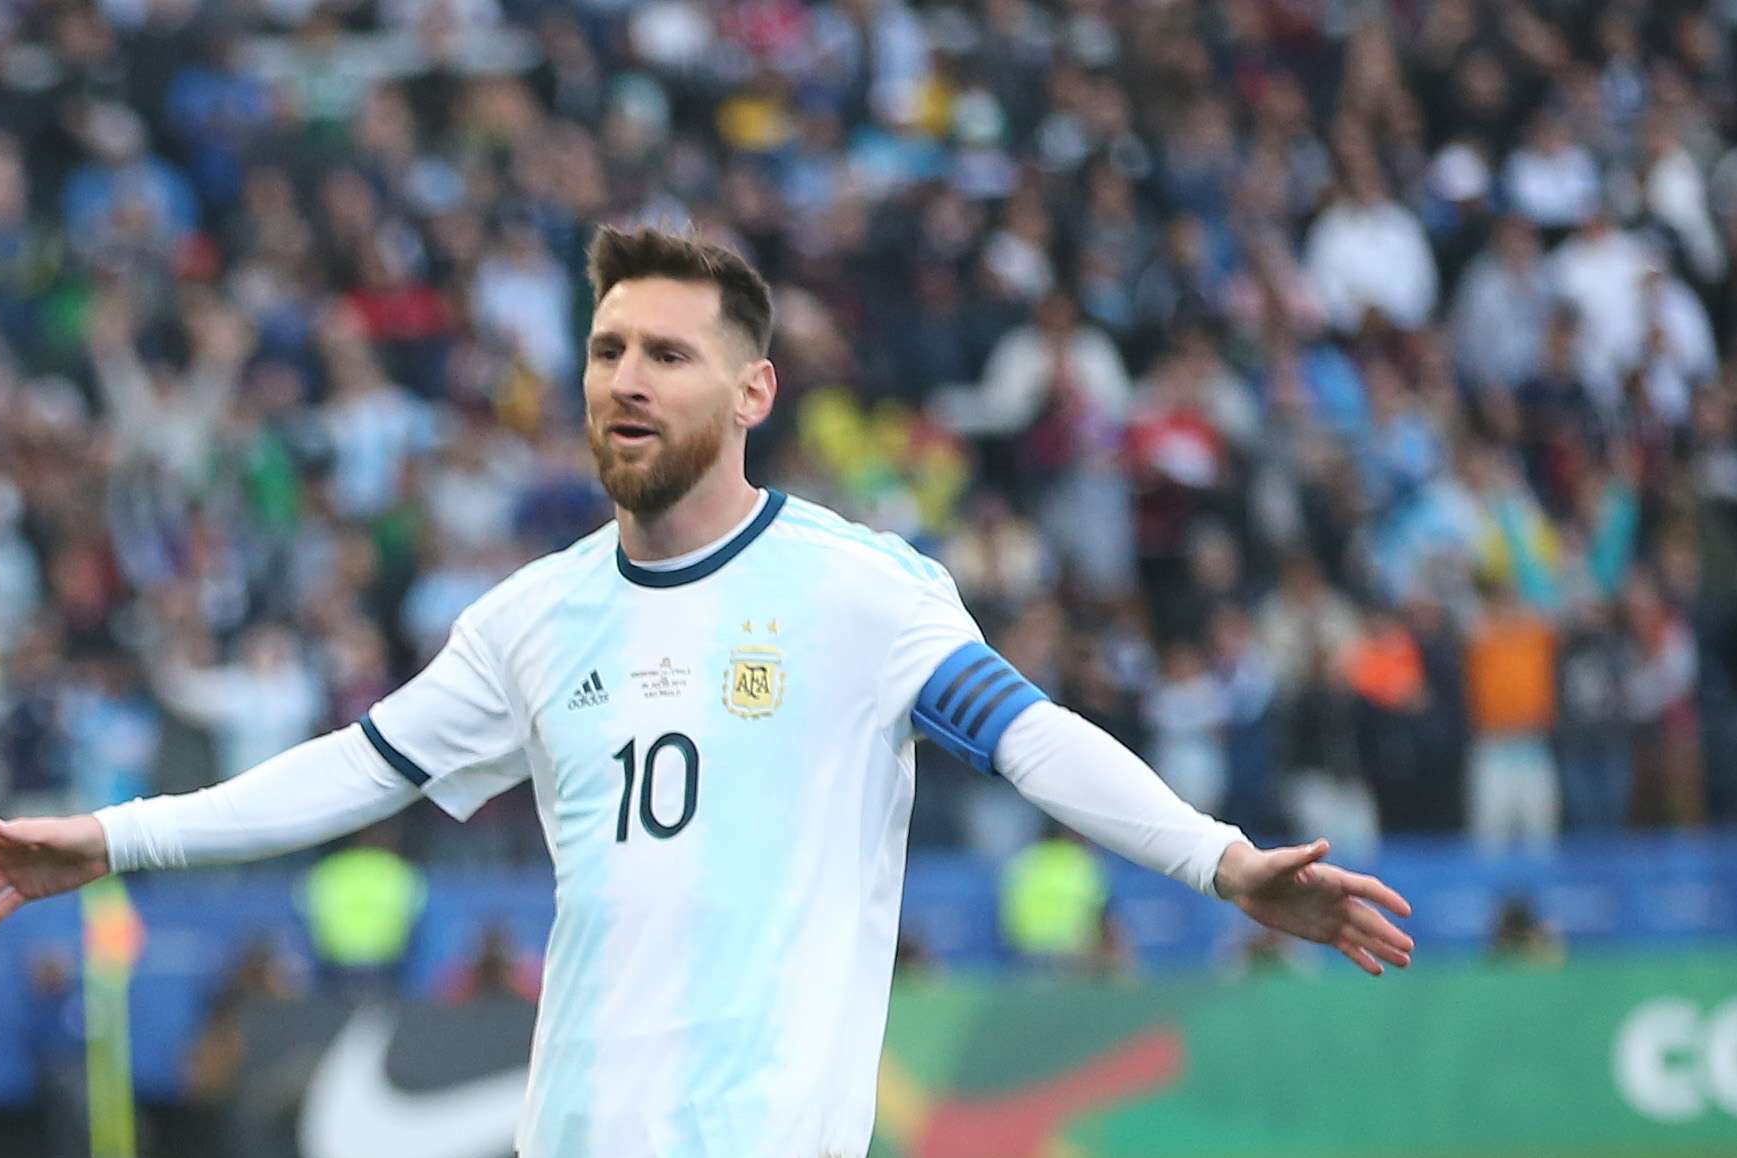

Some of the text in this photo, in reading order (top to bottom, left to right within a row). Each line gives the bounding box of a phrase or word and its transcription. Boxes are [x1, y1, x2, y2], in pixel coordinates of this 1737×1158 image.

[735, 662, 770, 700] AFA
[612, 731, 700, 843] 10
[1609, 996, 1737, 1122] C
